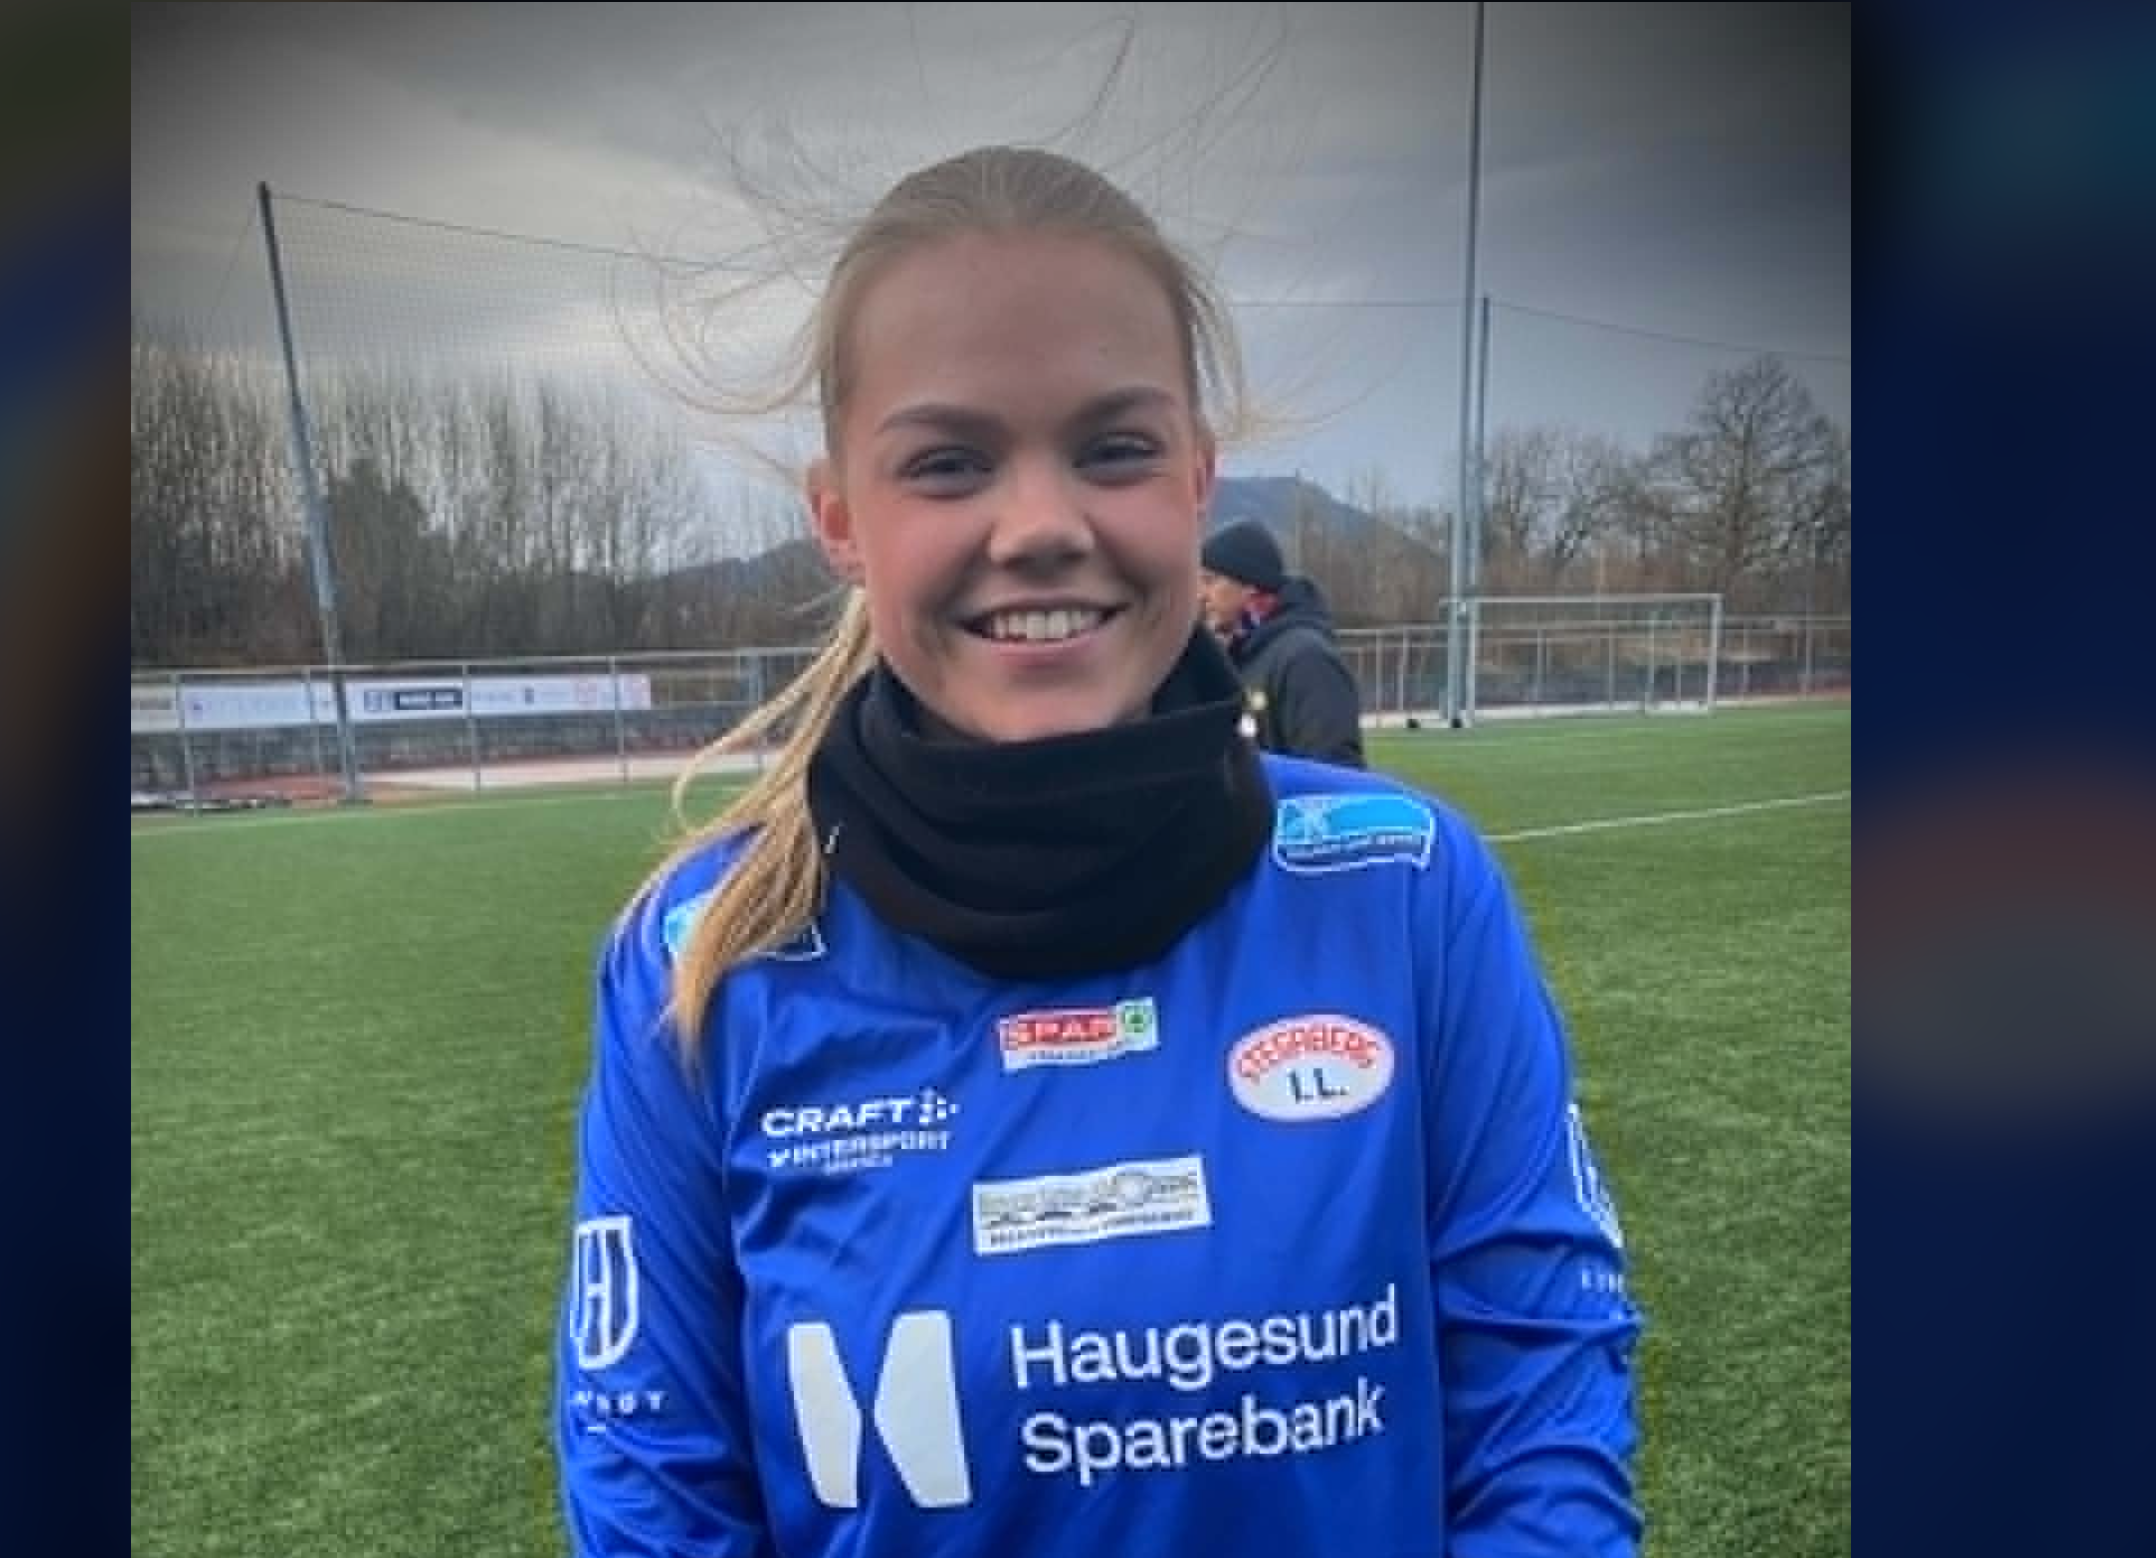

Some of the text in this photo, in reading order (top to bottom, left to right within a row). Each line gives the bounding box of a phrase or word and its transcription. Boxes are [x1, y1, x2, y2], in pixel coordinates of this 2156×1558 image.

[1005, 1014, 1115, 1050] SPAR
[760, 1097, 914, 1138] CRAFT
[1010, 1282, 1397, 1391] Haugesund
[1021, 1376, 1384, 1487] Sparebank
